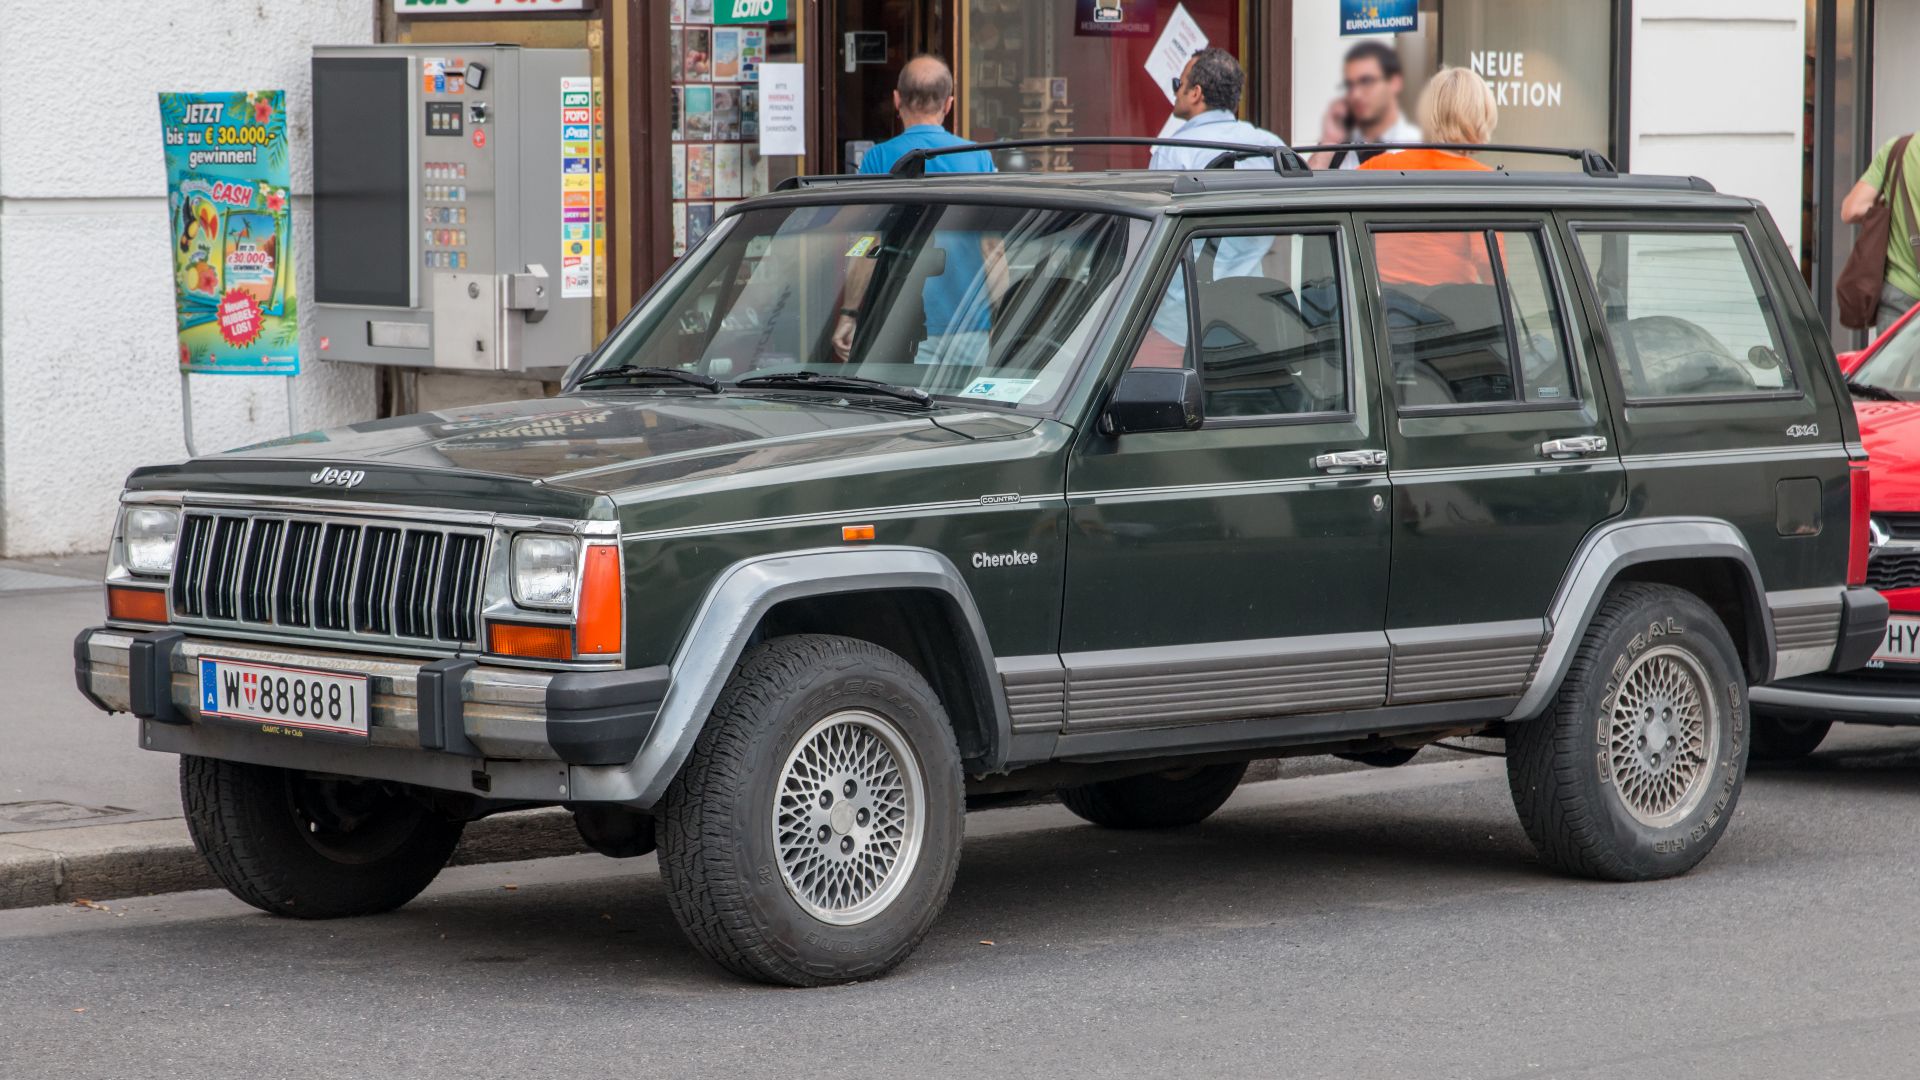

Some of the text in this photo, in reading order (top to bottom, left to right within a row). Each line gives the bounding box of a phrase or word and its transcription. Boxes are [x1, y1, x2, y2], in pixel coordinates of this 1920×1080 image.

[1346, 16, 1414, 30] EUROMILLIONEN
[1470, 51, 1524, 77] NEUE
[183, 103, 224, 124] JETZT
[565, 110, 589, 122] TOTO
[166, 127, 184, 144] bis
[187, 132, 202, 144] zu
[205, 126, 214, 144] €
[565, 127, 589, 138] JOKER
[189, 146, 257, 168] gewinnen!
[212, 182, 253, 206] CASH
[231, 320, 252, 336] LOS!
[310, 466, 365, 489] Jeep
[982, 495, 1018, 504] COUNTRY
[972, 550, 1038, 568] Cherokee
[207, 692, 215, 704] A
[1597, 617, 1683, 783] GENERAL
